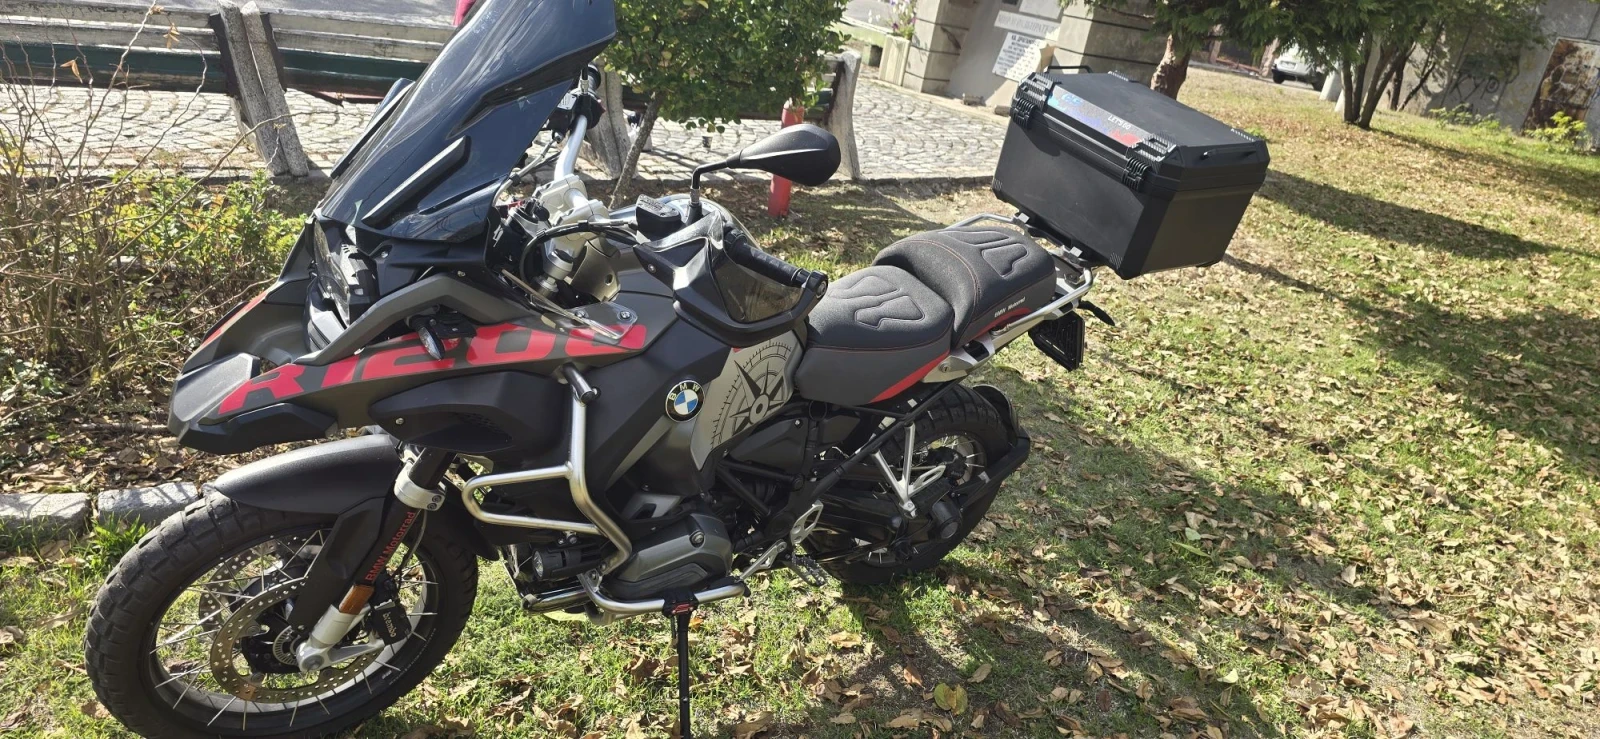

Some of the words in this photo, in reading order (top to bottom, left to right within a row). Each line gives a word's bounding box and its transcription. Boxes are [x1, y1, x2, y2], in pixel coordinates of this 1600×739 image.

[668, 382, 701, 401] BMW
[365, 556, 387, 581] BMW
[383, 511, 416, 556] Motorrad
[382, 611, 397, 638] brembo
